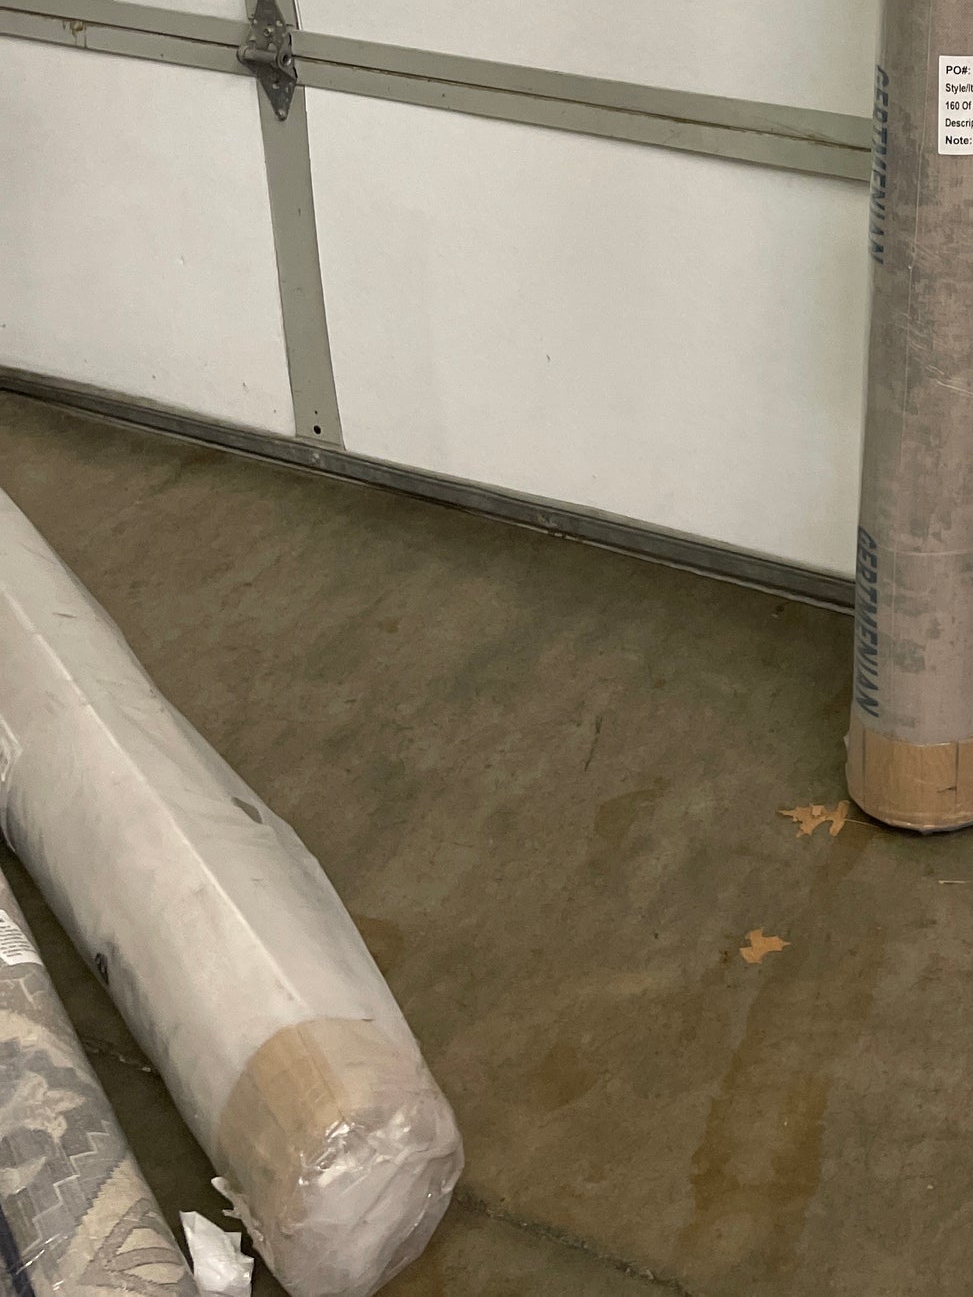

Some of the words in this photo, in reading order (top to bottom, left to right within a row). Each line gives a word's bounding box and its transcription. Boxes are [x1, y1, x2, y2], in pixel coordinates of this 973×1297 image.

[945, 65, 971, 75] PO#:
[945, 101, 960, 110] 160
[962, 101, 971, 110] Of
[945, 135, 973, 145] Note:
